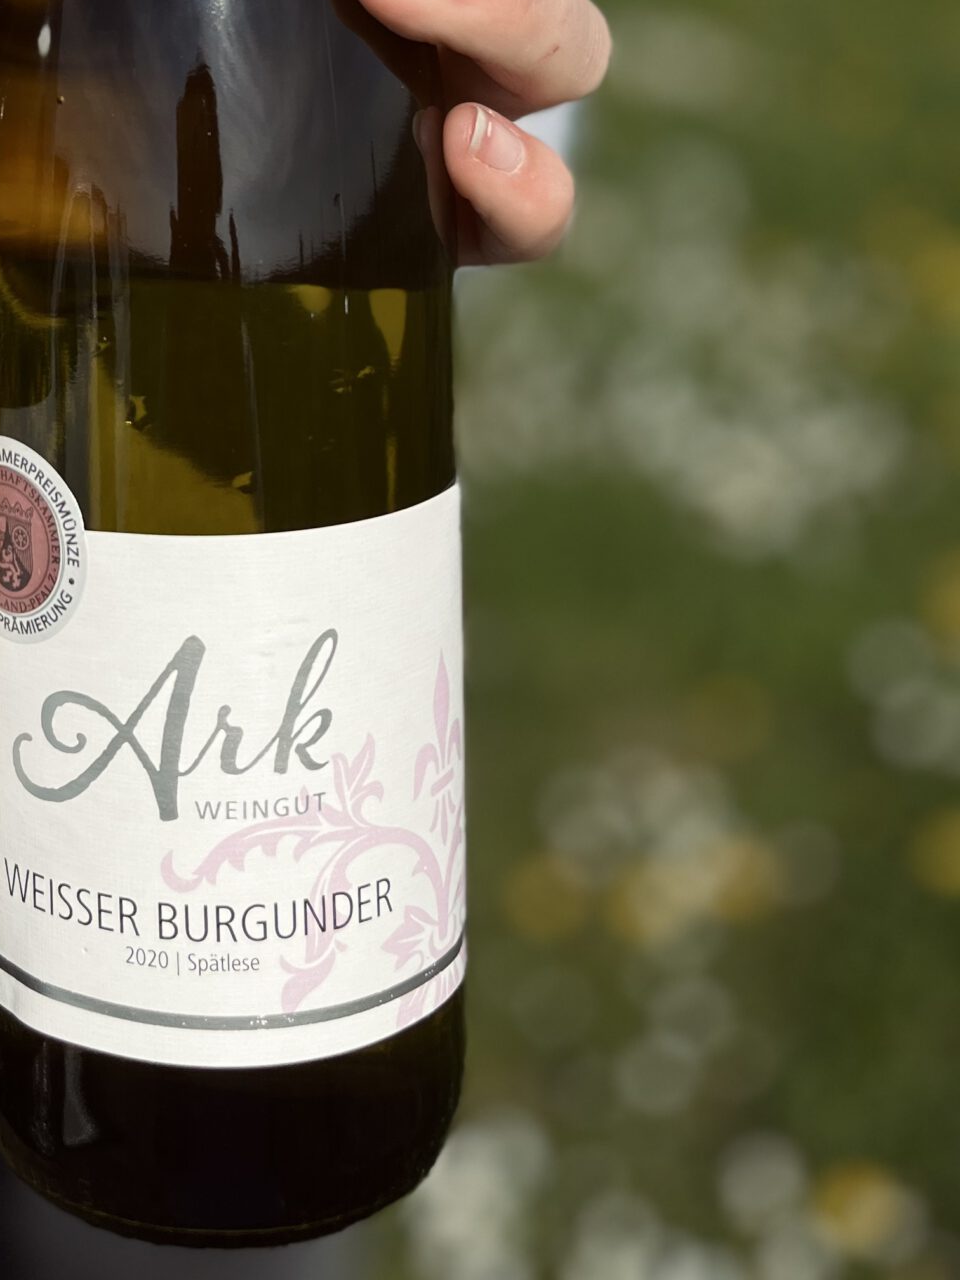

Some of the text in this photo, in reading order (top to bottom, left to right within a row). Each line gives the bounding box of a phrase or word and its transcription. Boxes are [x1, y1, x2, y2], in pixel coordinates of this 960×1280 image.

[12, 627, 340, 822] Ark
[194, 791, 326, 821] WEINGUT
[3, 857, 394, 944] WEISSER BURGUNDER
[125, 946, 169, 970] 2020
[187, 952, 261, 975] Spätlese
